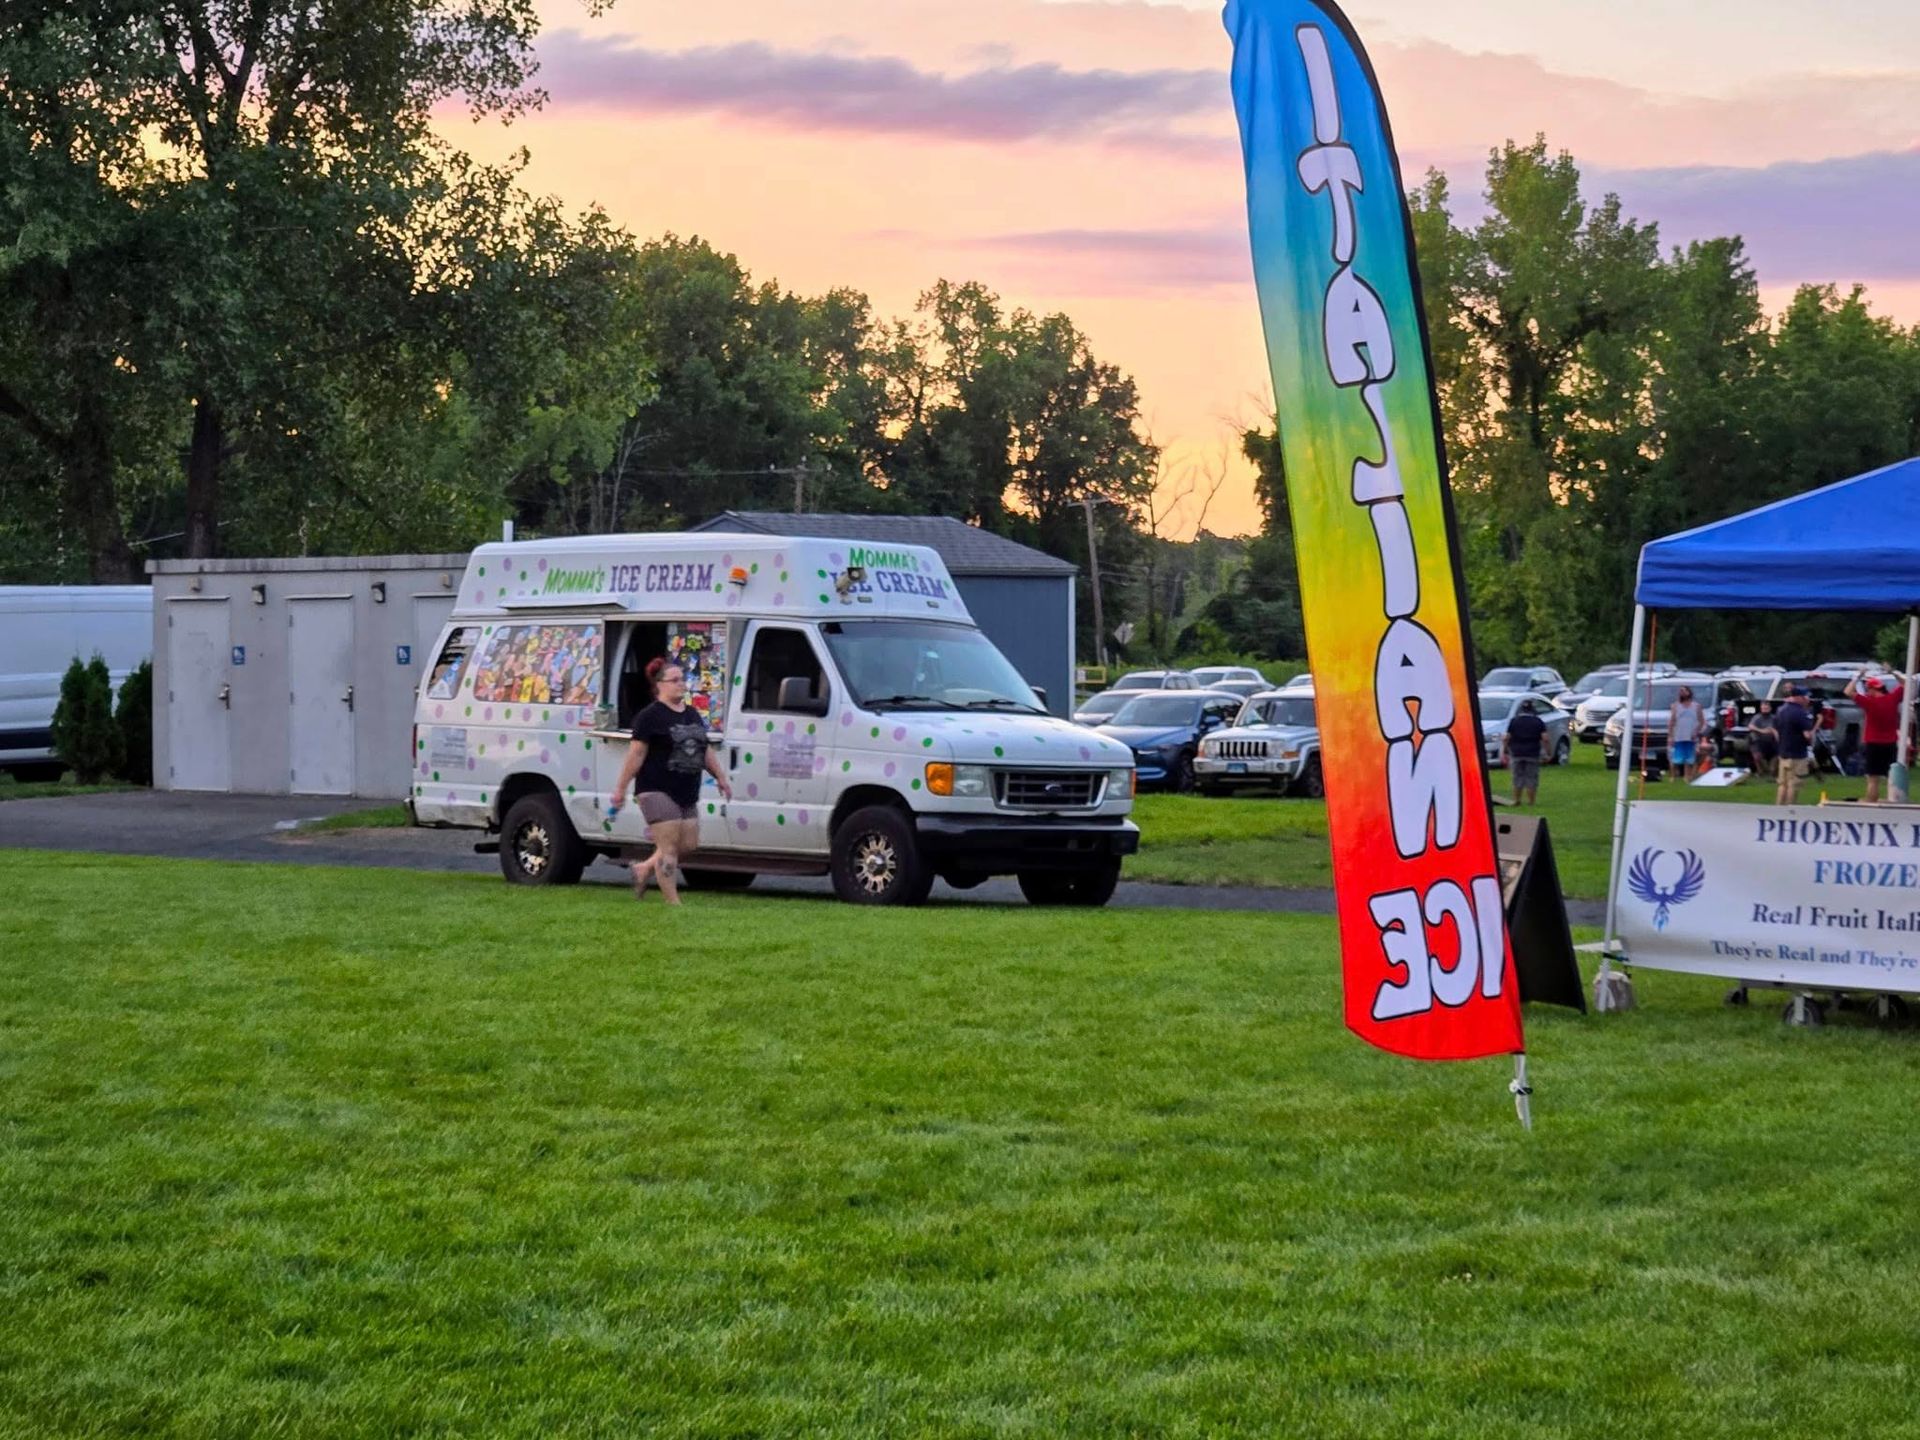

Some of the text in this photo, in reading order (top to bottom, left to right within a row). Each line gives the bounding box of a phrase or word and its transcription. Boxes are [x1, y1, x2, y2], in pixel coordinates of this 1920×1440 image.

[609, 565, 641, 593] ICE
[645, 563, 714, 592] CREAM
[875, 571, 948, 600] CREAM
[1756, 818, 1900, 848] PHOENIX
[1814, 860, 1920, 888] FROZE
[1752, 903, 1801, 925] Real
[1810, 906, 1868, 929] Fruit
[1711, 939, 1918, 972] They're Real and They're
